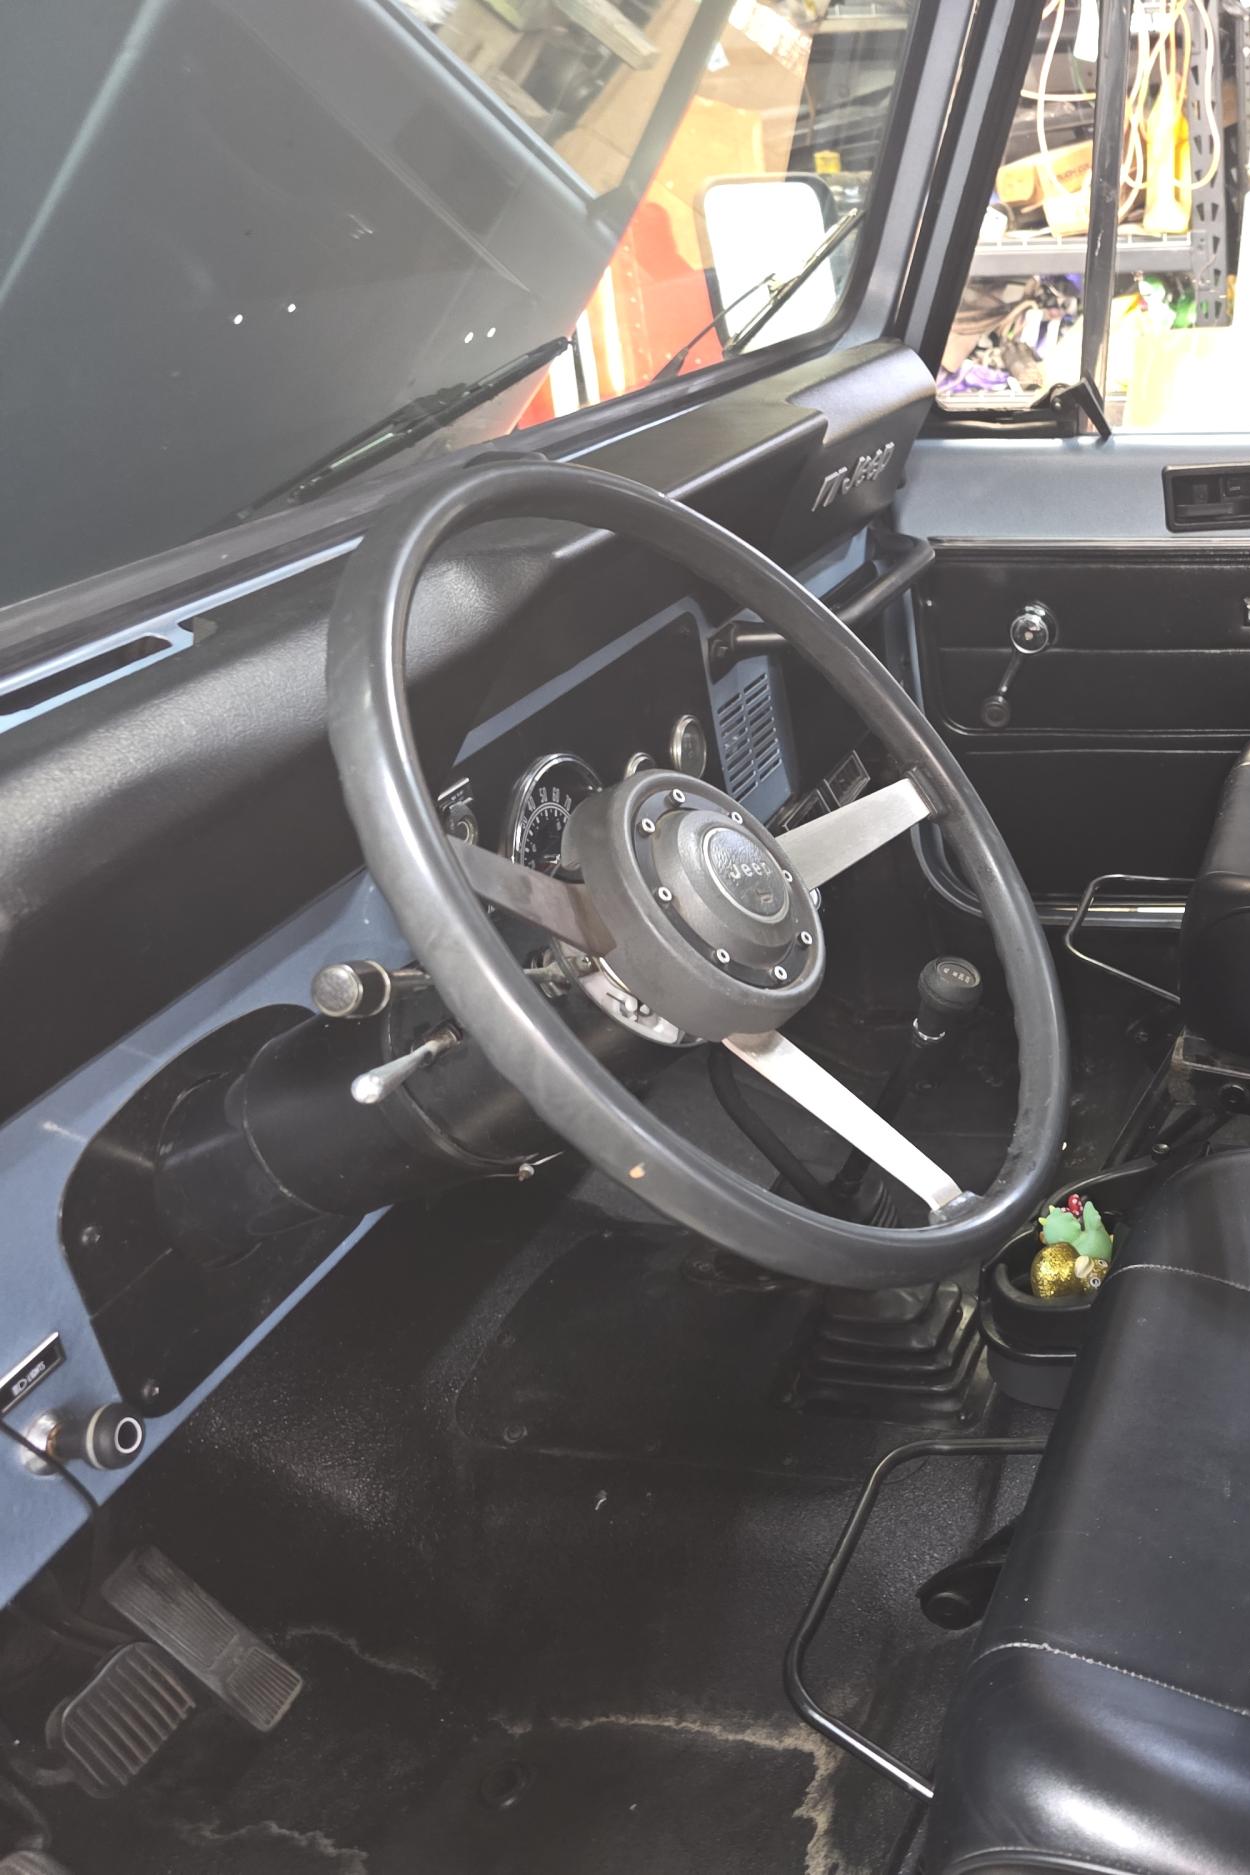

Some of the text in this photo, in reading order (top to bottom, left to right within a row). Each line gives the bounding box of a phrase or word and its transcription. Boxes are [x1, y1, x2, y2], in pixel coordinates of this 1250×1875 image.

[539, 786, 548, 803] 50
[552, 787, 560, 803] 60
[729, 862, 772, 880] Jeep
